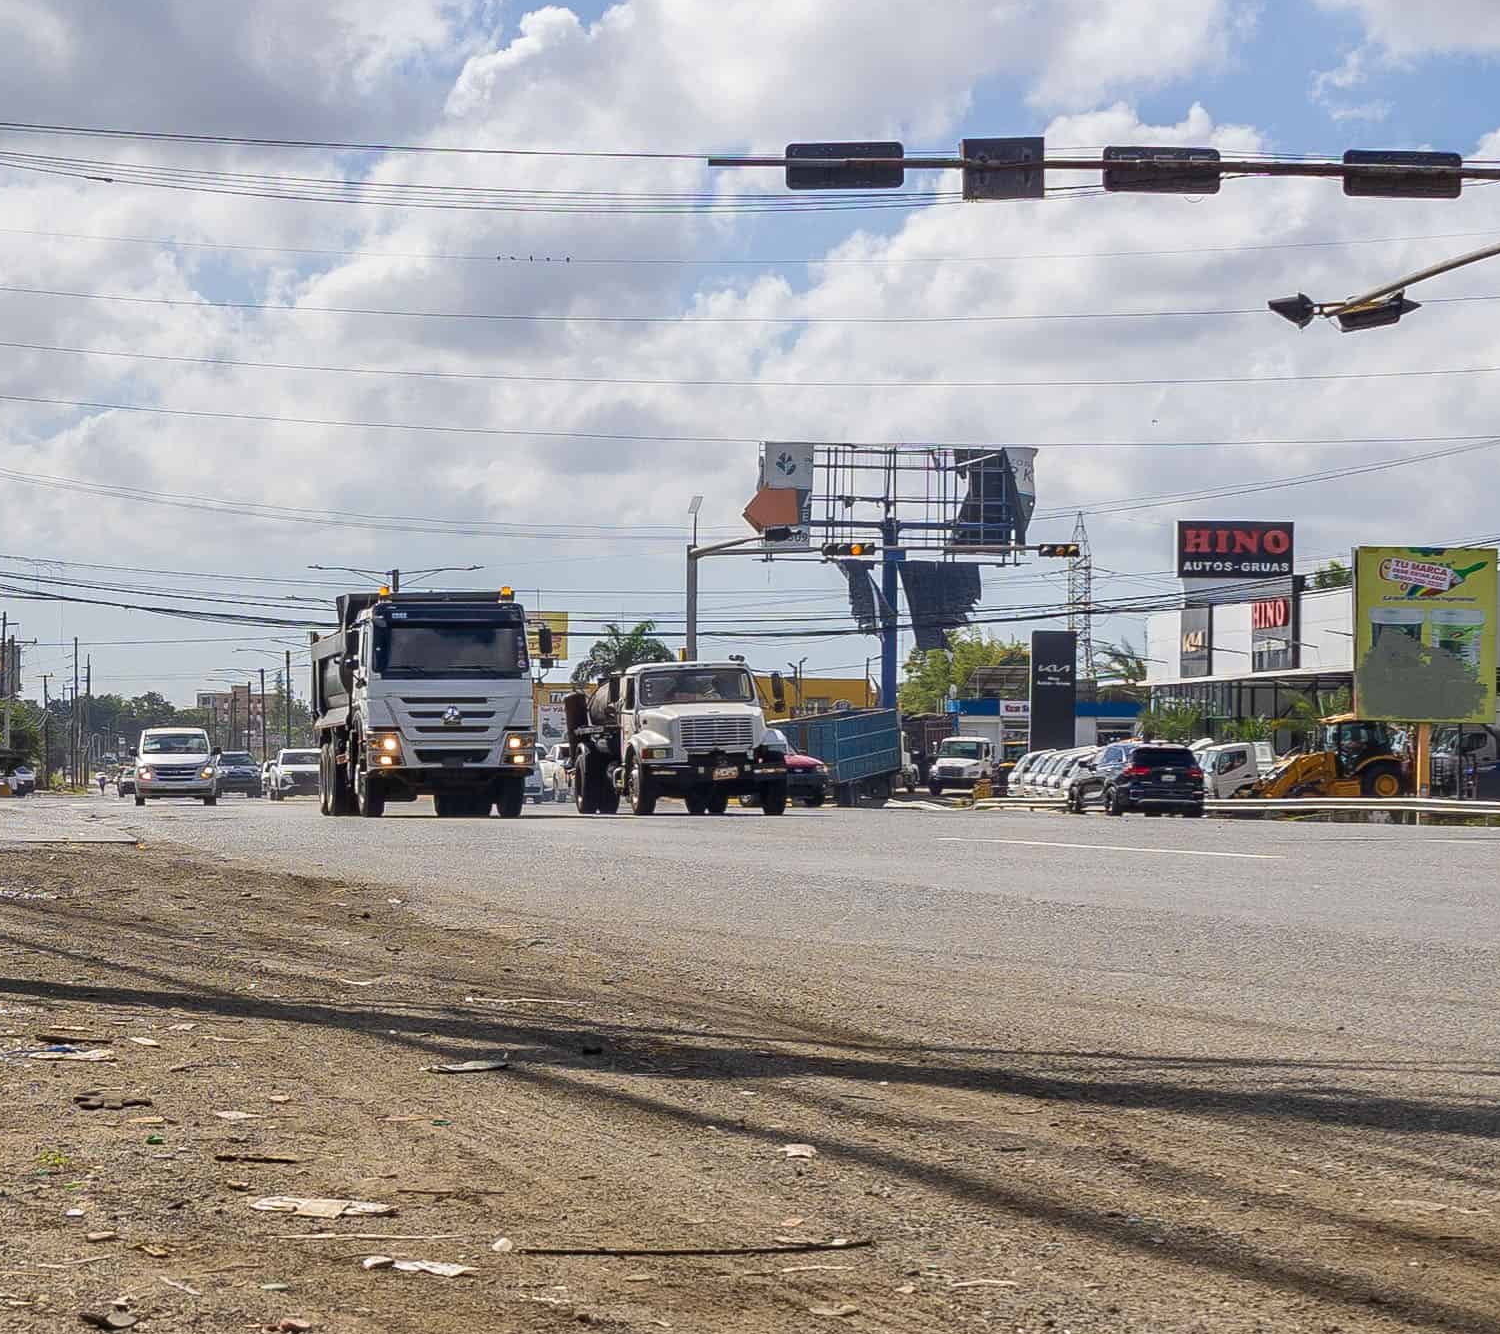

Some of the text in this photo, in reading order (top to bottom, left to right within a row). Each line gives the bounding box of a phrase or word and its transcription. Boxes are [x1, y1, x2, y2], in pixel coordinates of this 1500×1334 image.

[1184, 530, 1289, 554] HINO
[1183, 561, 1289, 572] AUTOS-GRUAS
[1393, 559, 1409, 569] TU
[1253, 600, 1286, 629] HINO
